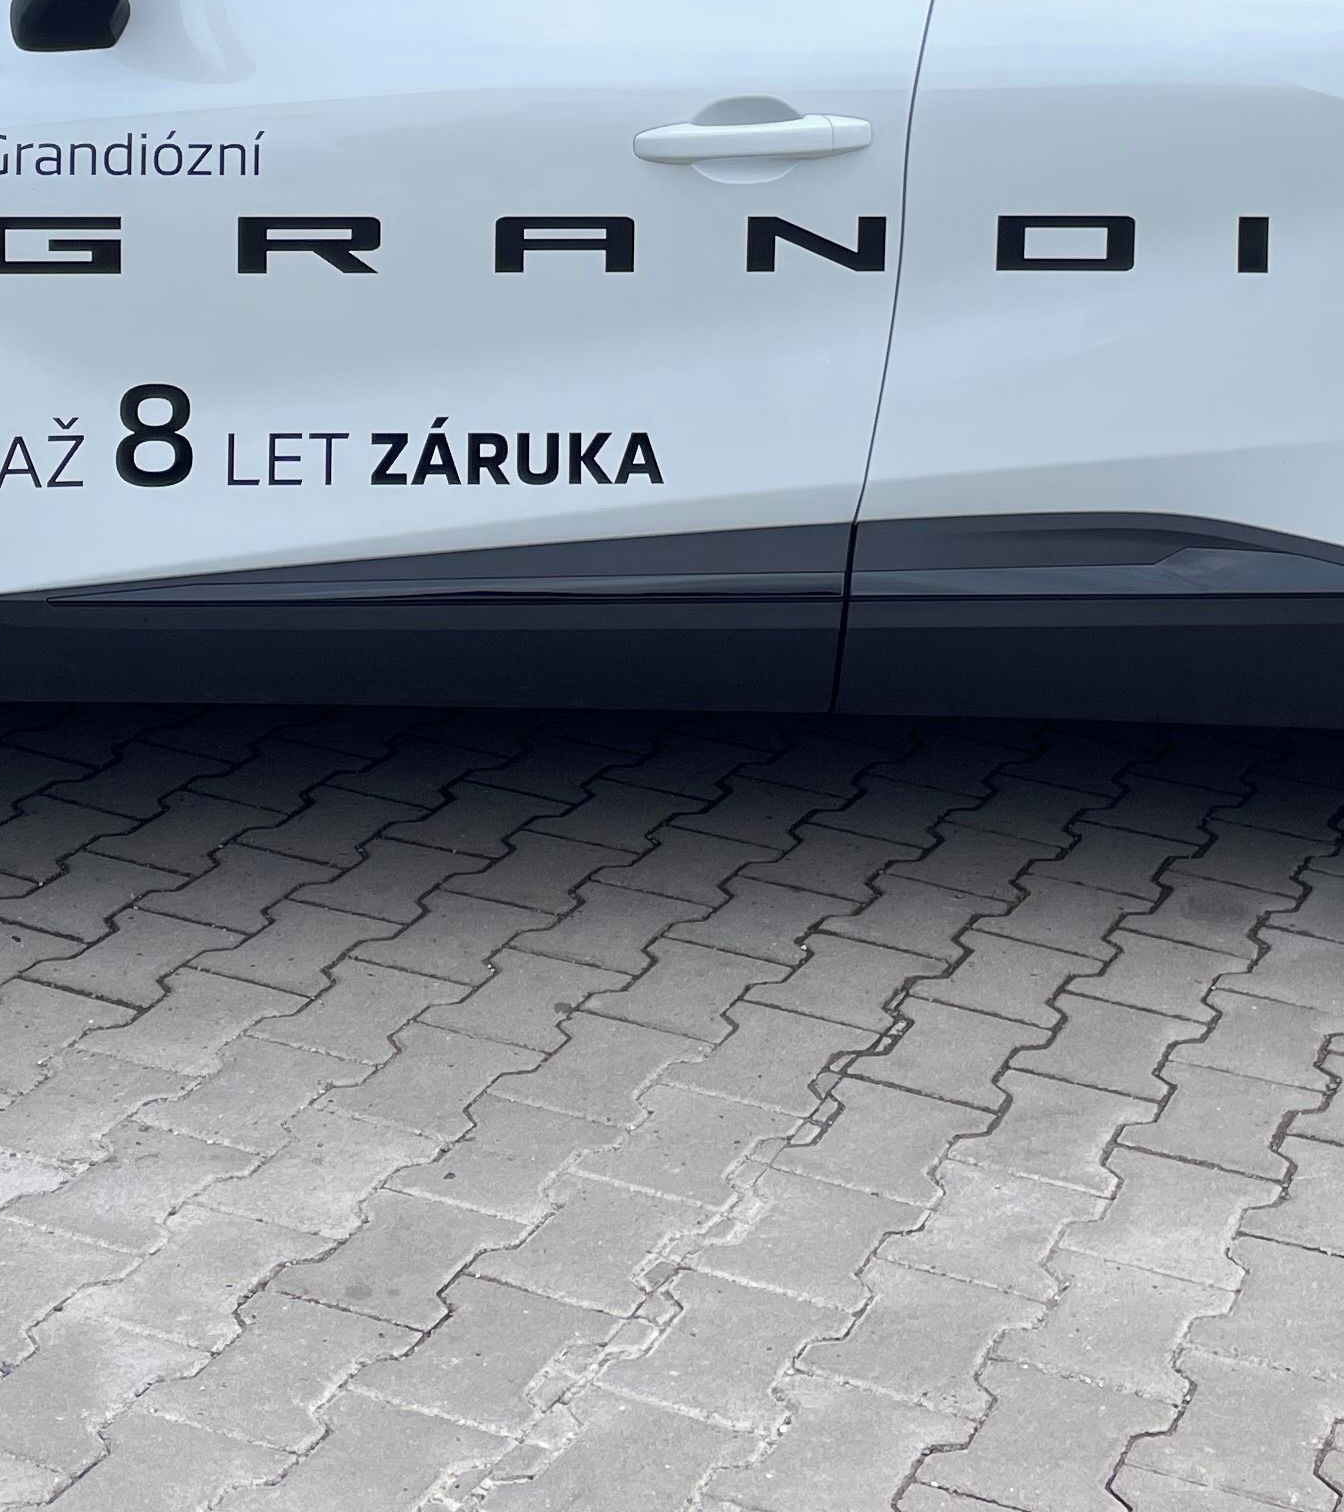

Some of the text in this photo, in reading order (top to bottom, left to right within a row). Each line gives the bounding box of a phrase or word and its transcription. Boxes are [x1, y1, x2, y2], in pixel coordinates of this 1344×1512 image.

[115, 383, 194, 488] 8
[227, 432, 350, 486] LET
[370, 416, 665, 486] ZÁRUKA
